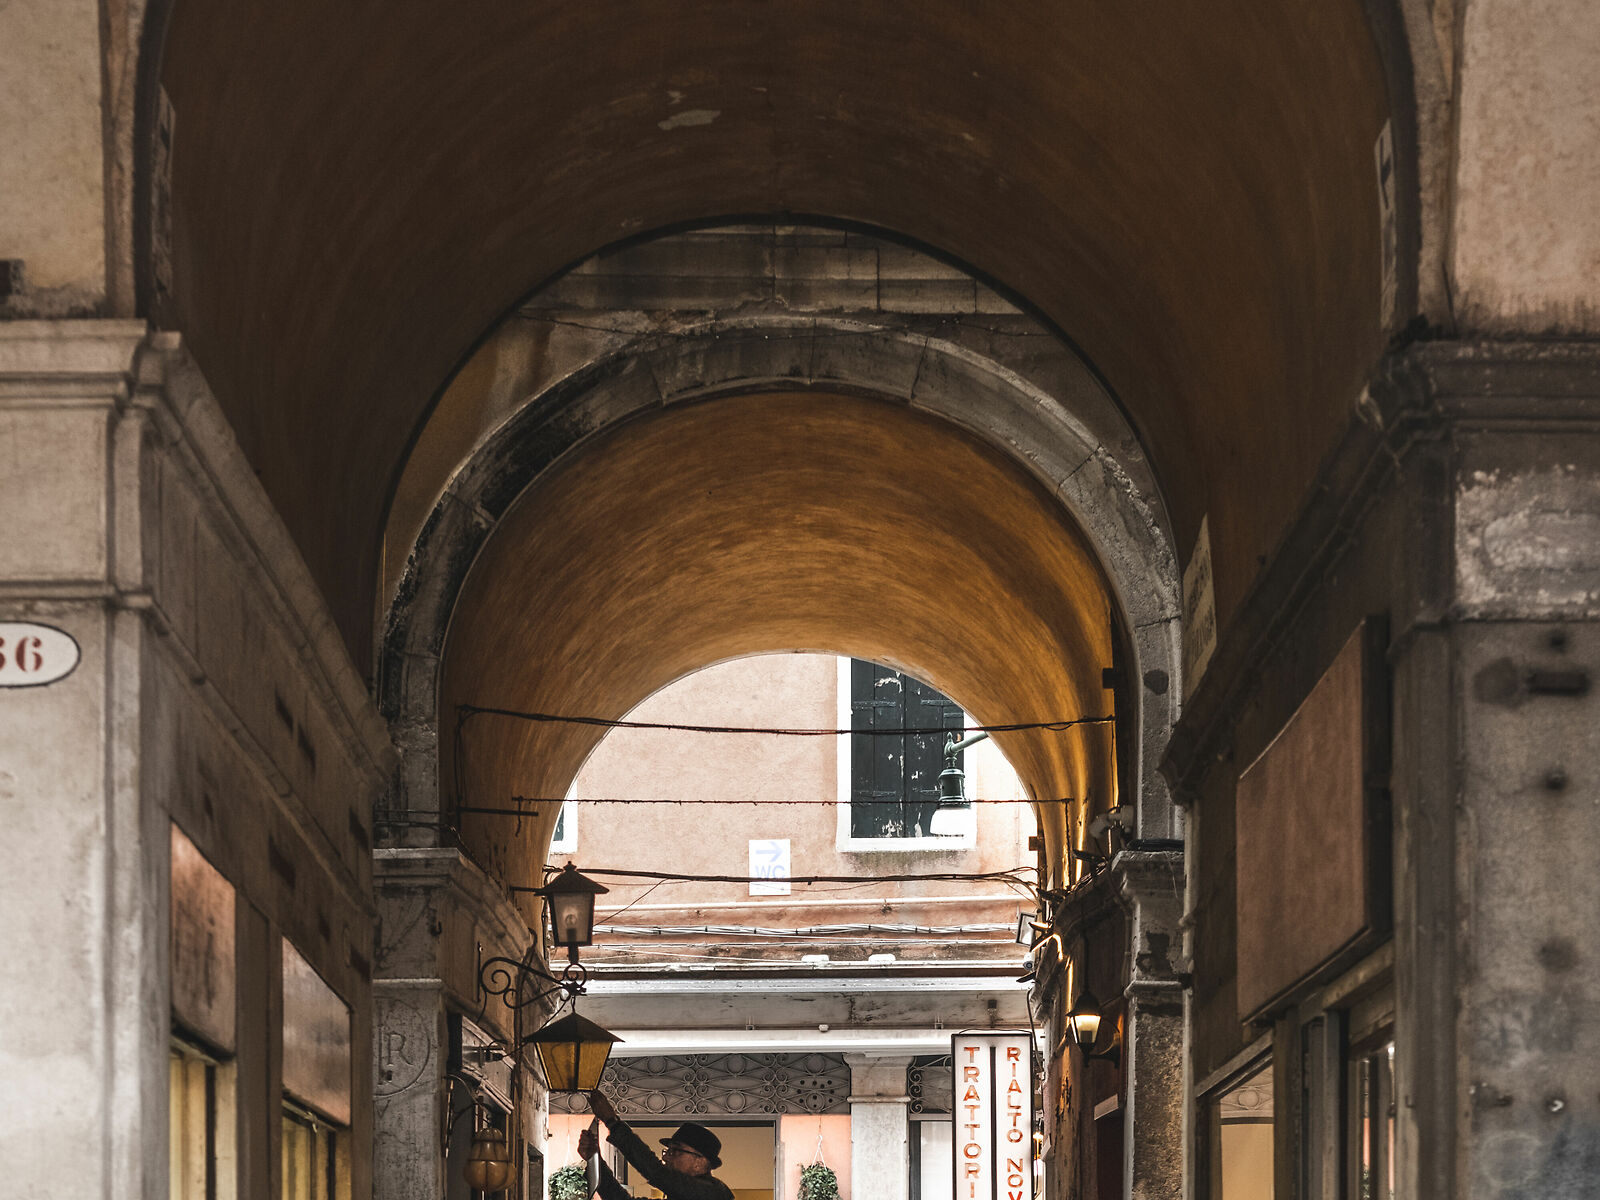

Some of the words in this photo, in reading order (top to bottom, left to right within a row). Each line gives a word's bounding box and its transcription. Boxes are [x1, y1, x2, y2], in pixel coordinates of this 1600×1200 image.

[0, 636, 42, 672] 6
[755, 864, 785, 879] WC
[1007, 1046, 1024, 1144] RIALTO
